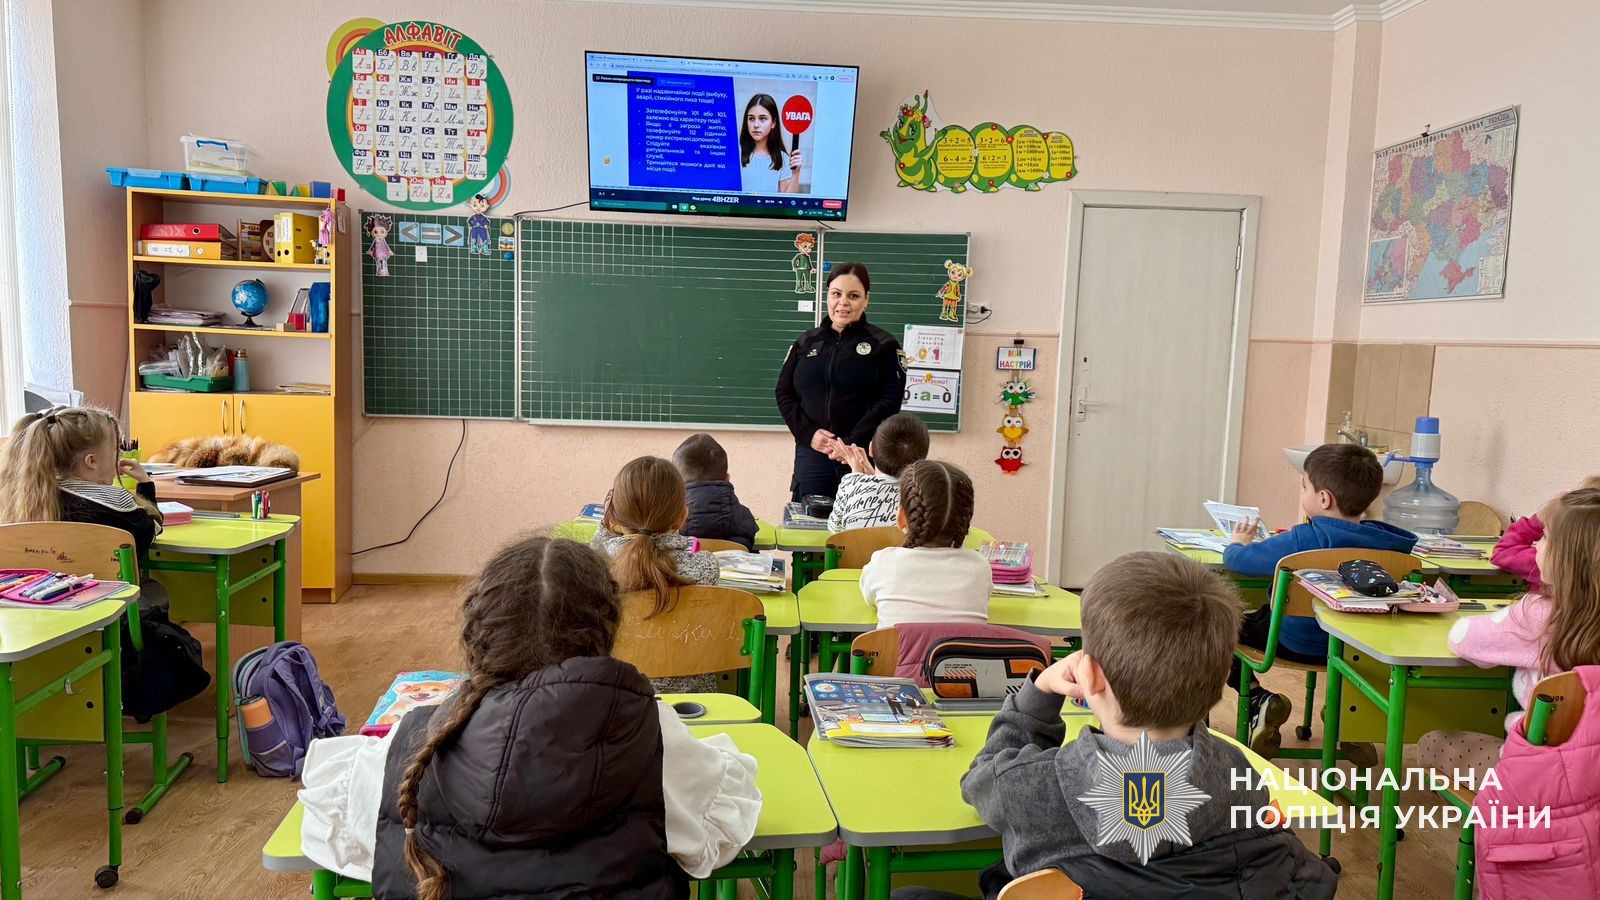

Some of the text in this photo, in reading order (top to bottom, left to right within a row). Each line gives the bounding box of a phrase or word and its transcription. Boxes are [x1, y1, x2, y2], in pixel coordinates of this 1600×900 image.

[384, 23, 462, 49] АЛФАВІТ
[646, 108, 688, 116] Зателефонуйте
[786, 111, 810, 121] УВАГА
[919, 348, 928, 360] 0
[932, 348, 940, 360] 1
[1000, 360, 1032, 368] НАСТРІЙ
[943, 392, 952, 403] 0
